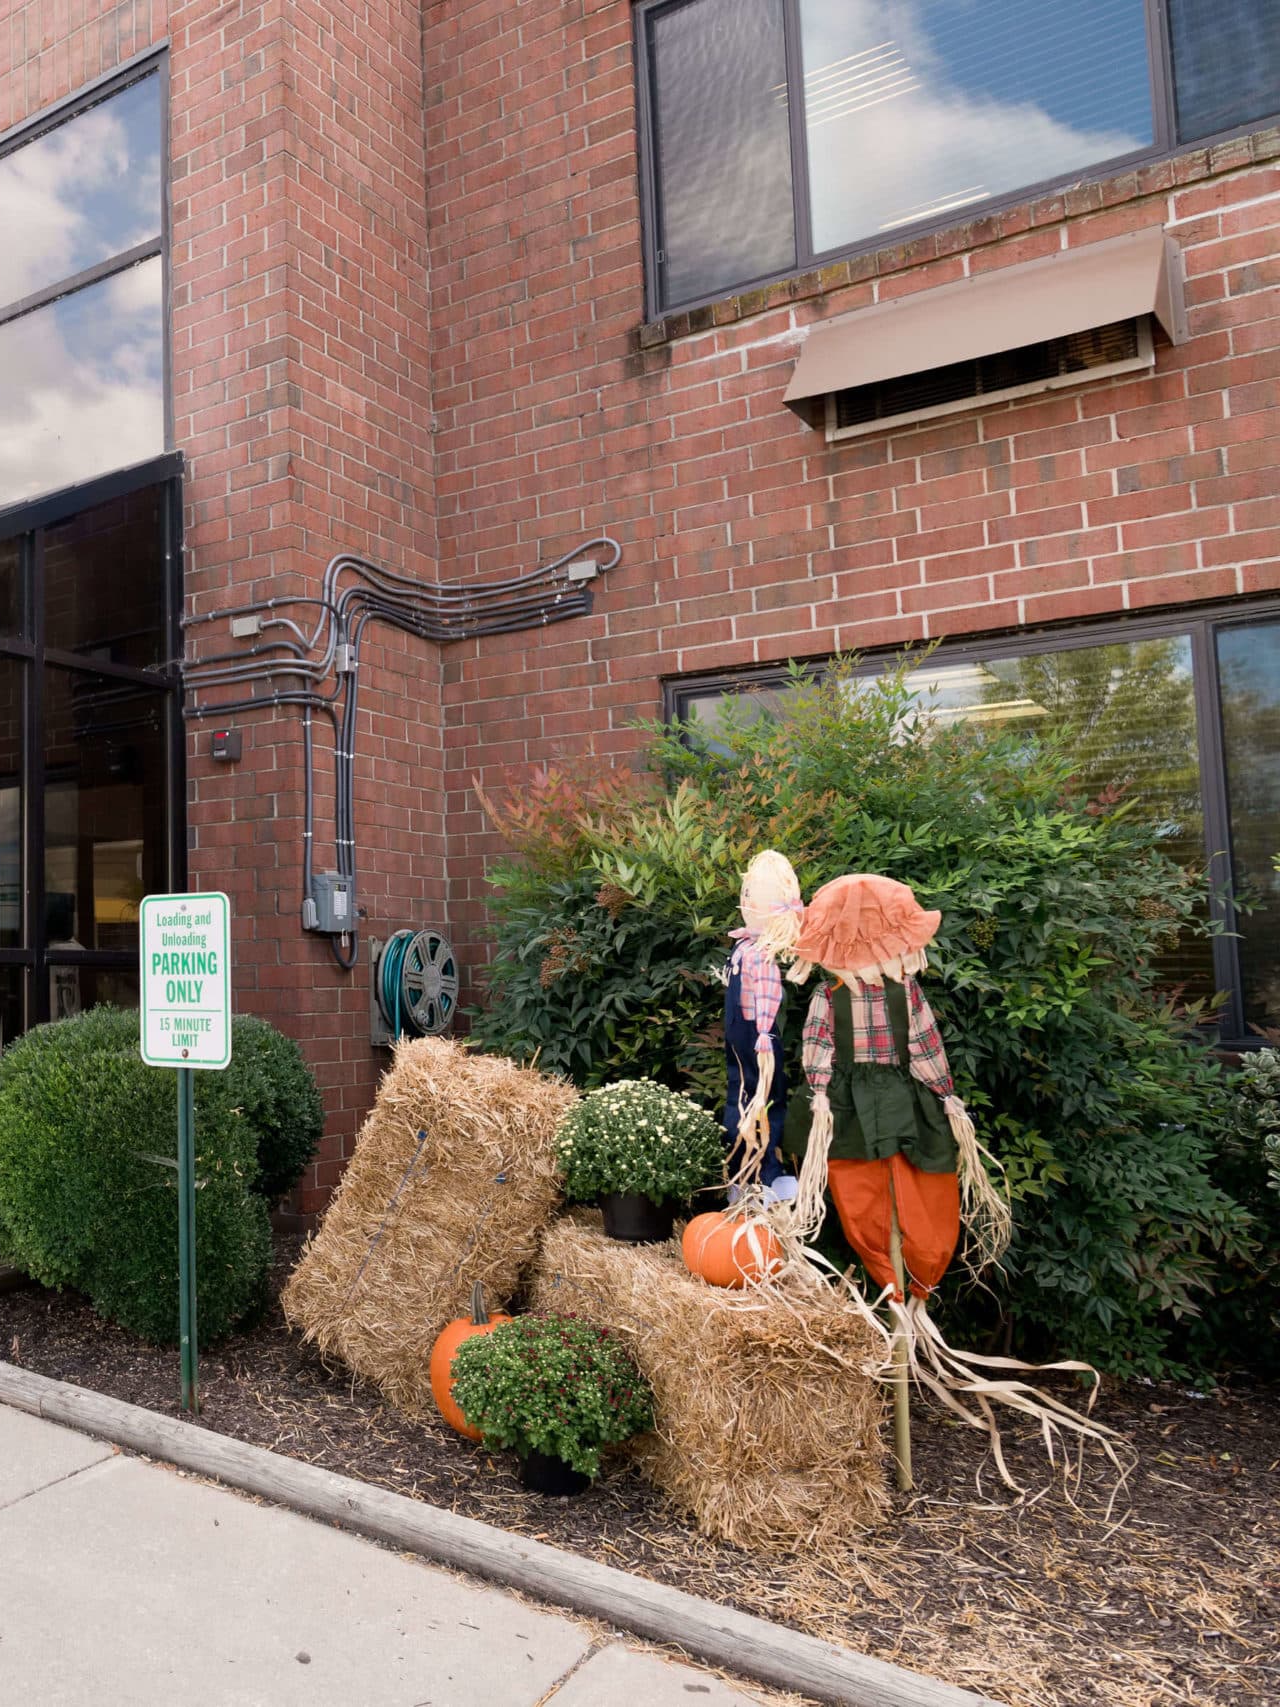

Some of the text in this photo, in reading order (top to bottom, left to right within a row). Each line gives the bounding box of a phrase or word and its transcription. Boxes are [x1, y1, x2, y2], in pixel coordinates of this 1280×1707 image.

[156, 911, 211, 928] Loading and
[161, 932, 207, 948] Unloading
[152, 951, 218, 976] PARKING
[166, 980, 203, 1003] ONLY
[160, 1017, 212, 1032] 15 MINUTE
[172, 1033, 198, 1047] LIMIT
